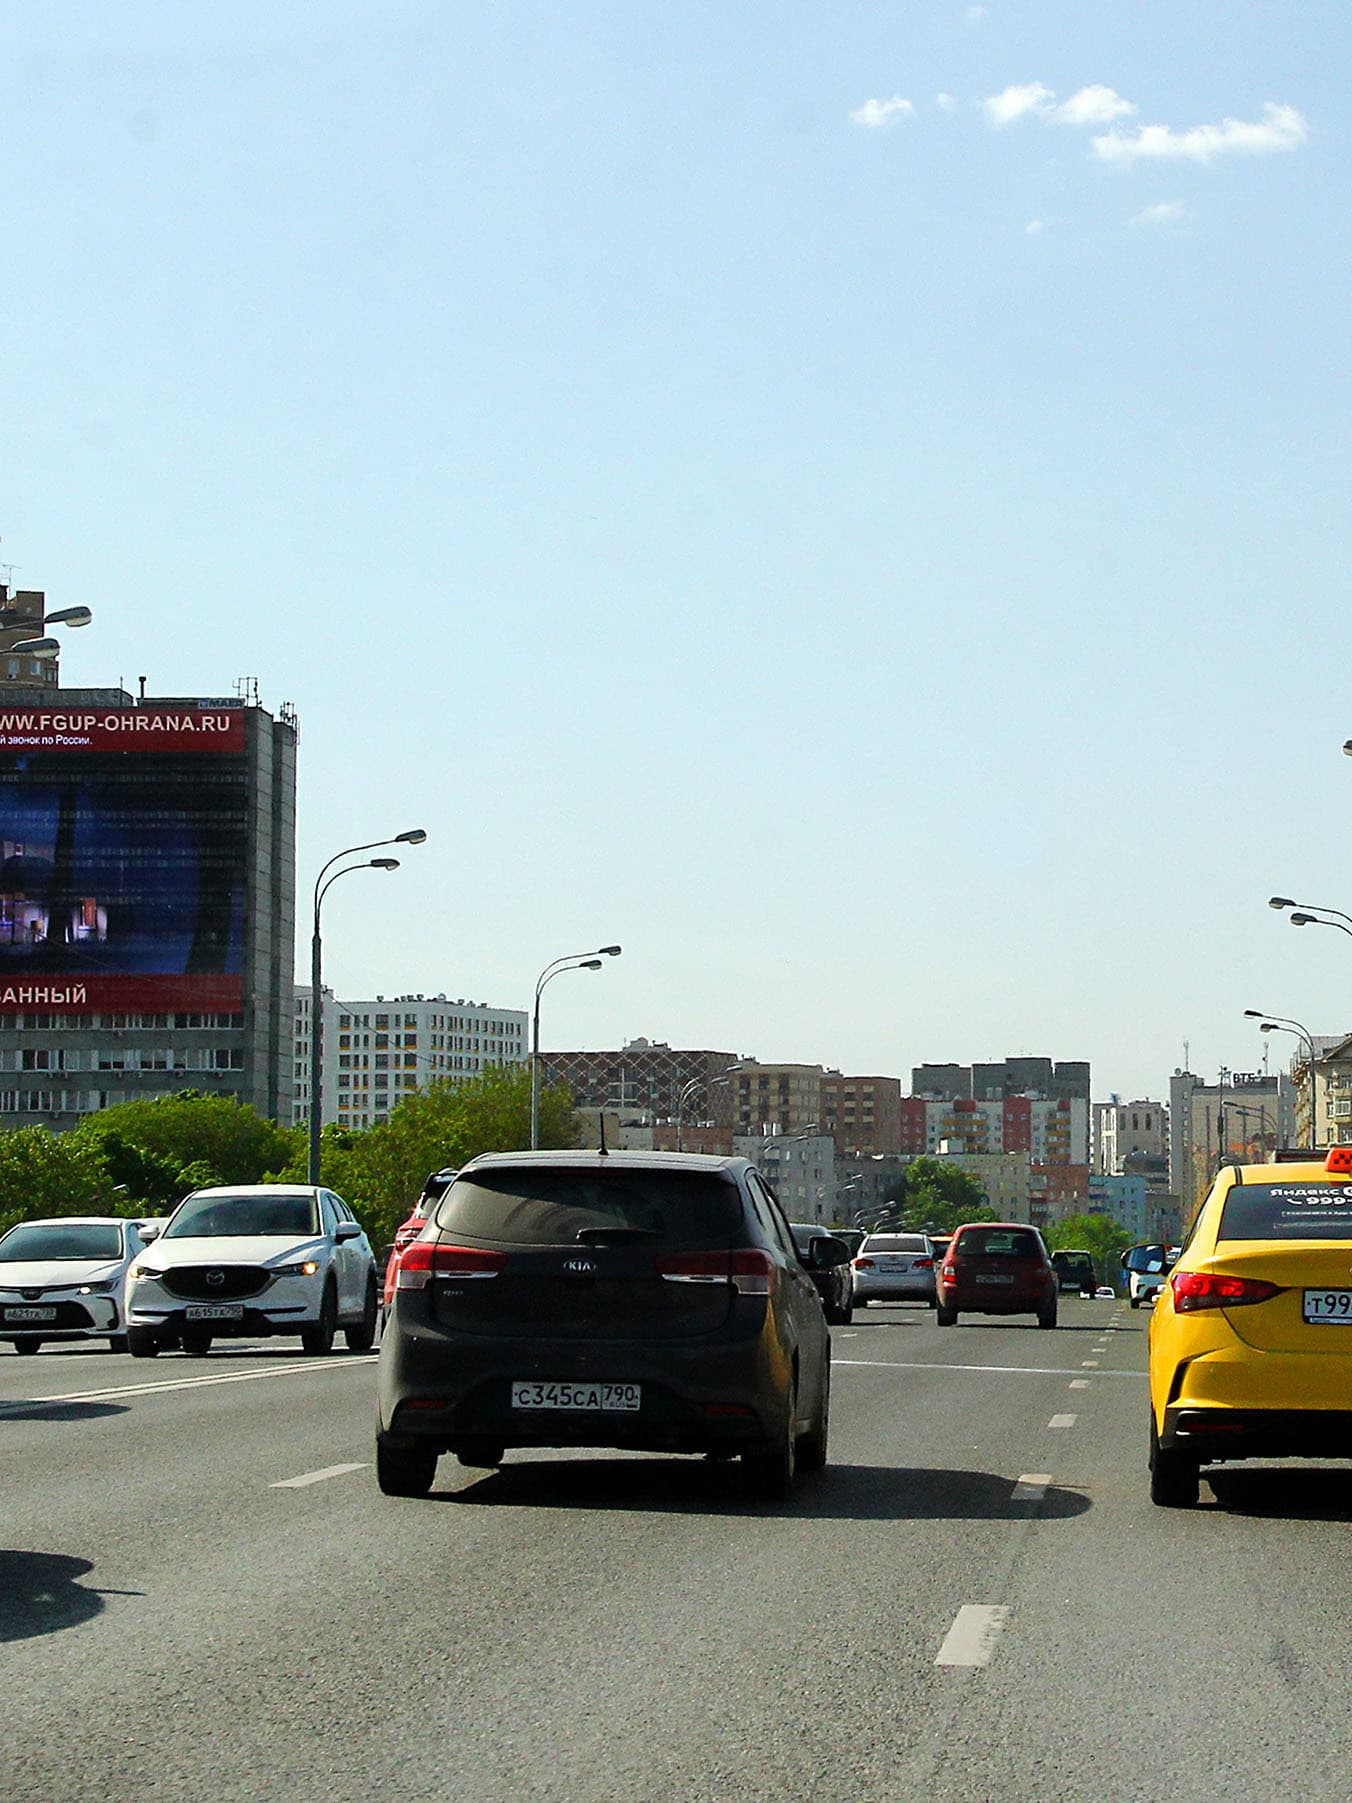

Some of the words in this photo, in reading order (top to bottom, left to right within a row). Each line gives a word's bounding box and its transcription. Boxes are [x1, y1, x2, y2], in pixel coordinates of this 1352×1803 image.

[8, 736, 40, 745] звонок
[41, 736, 54, 745] по
[0, 983, 87, 1004] АННЫЙ
[1270, 1188, 1340, 1197] Яндекс
[568, 1261, 592, 1271] KIA
[603, 1385, 635, 1402] 790
